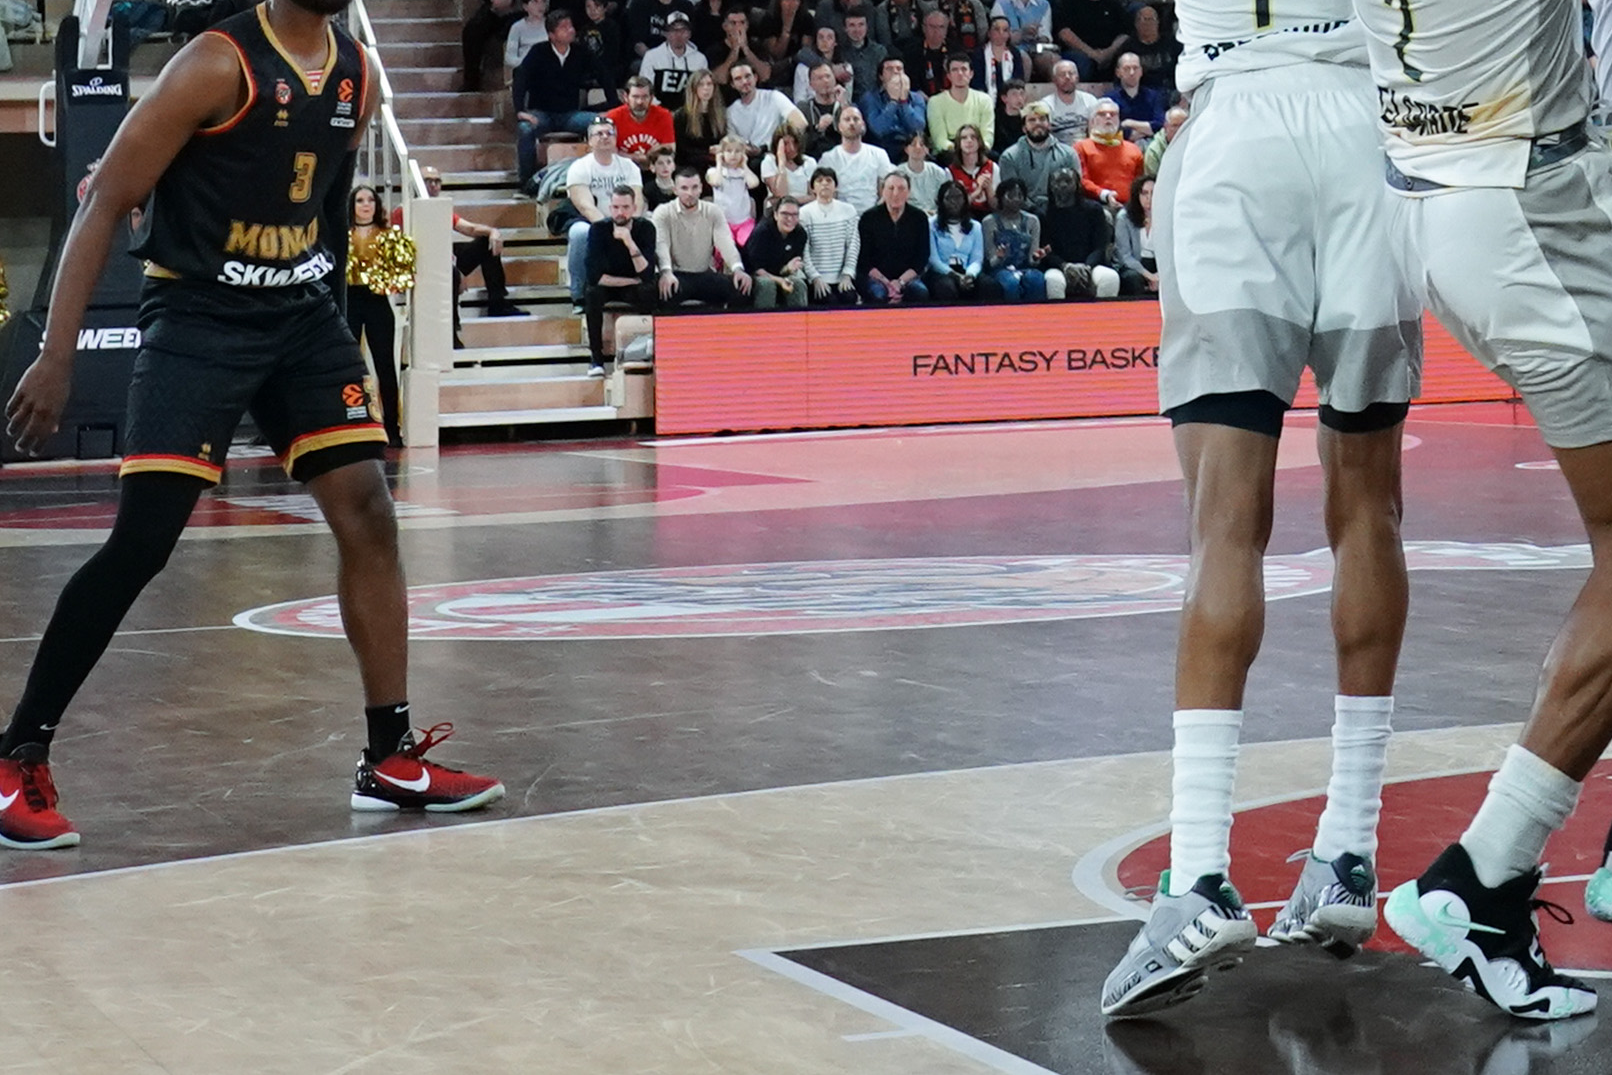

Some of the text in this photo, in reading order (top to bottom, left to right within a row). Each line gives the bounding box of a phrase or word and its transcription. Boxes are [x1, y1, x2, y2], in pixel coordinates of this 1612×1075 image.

[71, 83, 123, 97] SPALDING
[288, 151, 318, 203] 3
[912, 350, 1059, 377] FANTASY
